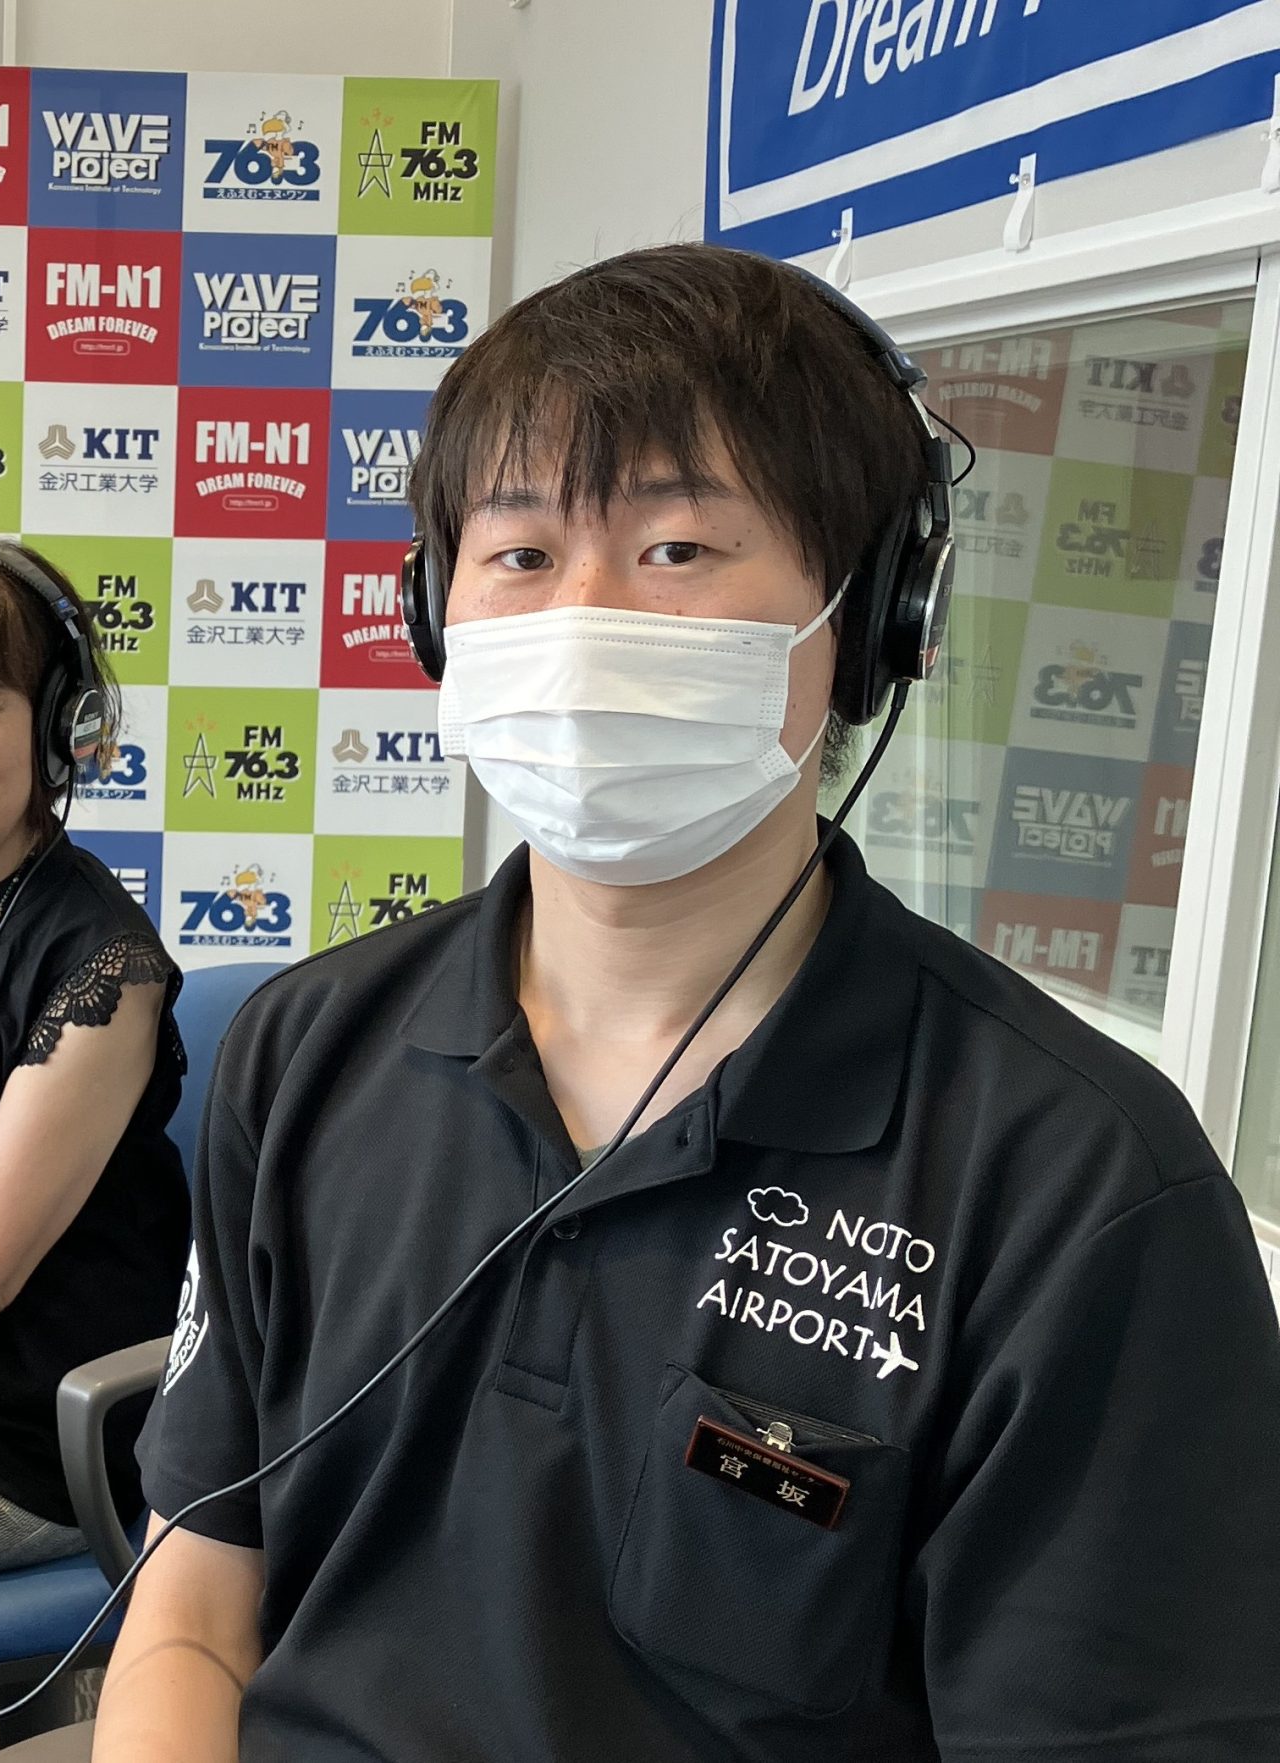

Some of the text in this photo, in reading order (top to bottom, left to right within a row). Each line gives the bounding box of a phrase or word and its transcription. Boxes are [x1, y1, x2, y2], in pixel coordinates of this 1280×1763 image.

[42, 111, 169, 153] WAVE
[421, 121, 461, 146] FM
[400, 148, 479, 180] 76.3
[412, 182, 463, 202] MHz
[45, 262, 161, 309] FM-N1
[193, 272, 320, 312] WAVE
[45, 316, 159, 344] DREAM FOREVER
[82, 428, 160, 460] KIT
[195, 420, 311, 465] FM-N1
[38, 471, 159, 494] 金沢工業大学
[195, 472, 307, 500] DREAM FOREVER
[351, 466, 410, 498] Proj
[98, 574, 137, 598] FM
[230, 580, 307, 614] KIT
[186, 625, 306, 646] 金沢工業大学
[342, 624, 391, 649] DREAM
[243, 726, 283, 749] FM
[376, 731, 445, 762] KIT
[224, 751, 300, 781] 76.3
[236, 783, 285, 801] MHz
[332, 774, 450, 795] 金沢工業大学
[389, 873, 428, 896] FM
[825, 1208, 936, 1273] NOTO
[714, 1227, 926, 1331] SATOYAMA
[696, 1279, 874, 1360] AIRPORT
